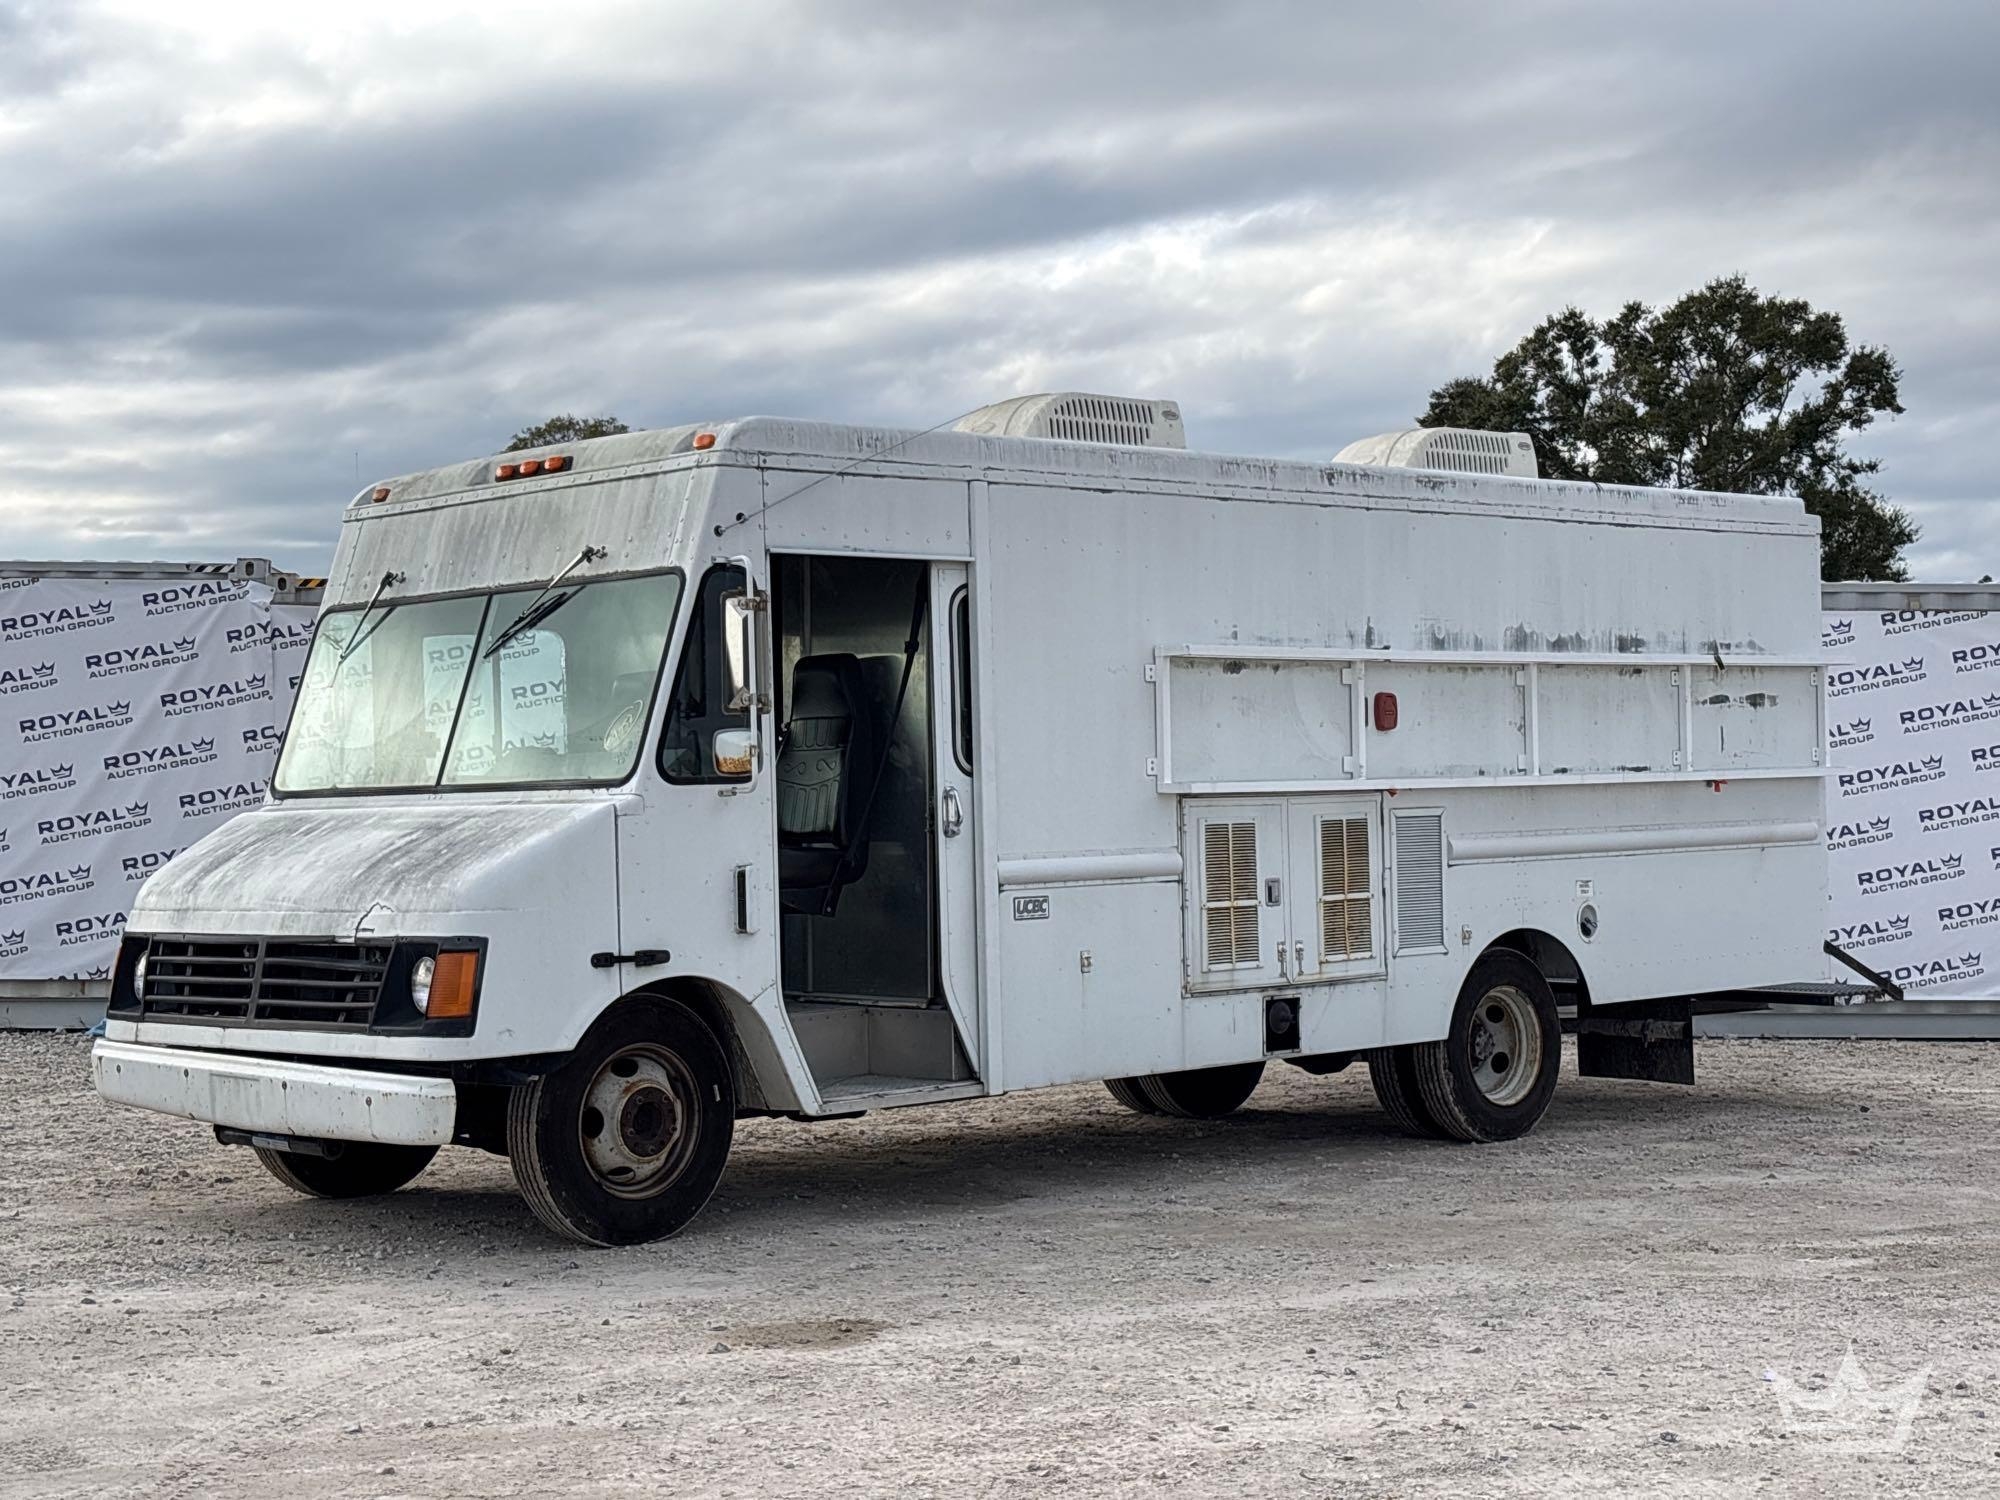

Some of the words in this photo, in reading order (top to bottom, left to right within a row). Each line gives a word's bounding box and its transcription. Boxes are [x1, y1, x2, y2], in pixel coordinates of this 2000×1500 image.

[0, 577, 40, 590] ROUP
[142, 580, 230, 606] ROYAL
[146, 600, 206, 616] AUCTION
[208, 589, 250, 605] GROUP
[1, 606, 90, 632] ROYAL
[4, 624, 65, 642] AUCTION
[67, 616, 115, 631] GROUP
[1884, 619, 1941, 636] AUCTION
[1943, 610, 1988, 624] GROUP
[85, 642, 173, 669] ROYAL
[502, 648, 540, 660] ROUP
[1952, 643, 2000, 664] ROY
[88, 662, 150, 680] AUCTION
[152, 652, 200, 667] GROUP
[1955, 658, 2000, 674] AUCTIO
[10, 678, 58, 693] GROUP
[511, 680, 564, 700] ROY
[1882, 672, 1928, 688] GROUP
[160, 681, 246, 707] ROYAL
[164, 700, 224, 717] AUCTION
[227, 690, 270, 706] GROUP
[20, 707, 108, 734] ROYAL
[1900, 700, 1982, 724] ROYAL
[1903, 717, 1960, 734] AUCTION
[1962, 708, 2000, 724] GROU
[23, 726, 83, 744] AUCTION
[86, 717, 134, 732] GROUP
[1829, 734, 1875, 748] GROUP
[104, 744, 192, 770] ROYAL
[107, 763, 168, 780] AUCTION
[170, 754, 218, 768] GROUP
[0, 770, 51, 788] YAL
[1838, 762, 1922, 788] ROYAL
[1842, 780, 1899, 798] AUCTION
[1900, 771, 1946, 786] GROUP
[29, 780, 76, 795] GROUP
[179, 782, 264, 808] ROYAL
[182, 800, 240, 818] AUCTION
[1918, 798, 2000, 822] ROYAL
[38, 808, 126, 835] ROYAL
[40, 827, 102, 845] AUCTION
[104, 818, 152, 834] GROUP
[1827, 822, 1869, 841] YAL
[1922, 815, 1979, 833] AUCTION
[1848, 832, 1894, 847] GROUP
[122, 848, 182, 871] ROY
[0, 871, 69, 894] OYAL
[1857, 860, 1941, 886] ROYAL
[1861, 878, 1918, 896] AUCTION
[1920, 870, 1966, 884] GROUP
[0, 890, 44, 906] CTION
[47, 880, 95, 897] GROUP
[1938, 898, 2000, 922] ROYA
[56, 912, 128, 936] ROYA
[1942, 914, 1998, 932] AUCTION
[60, 928, 120, 946] AUCTION
[1868, 930, 1912, 946] GROUP
[0, 946, 28, 958] OUP
[1897, 978, 1938, 990] CTION
[1940, 968, 1985, 983] GROUP
